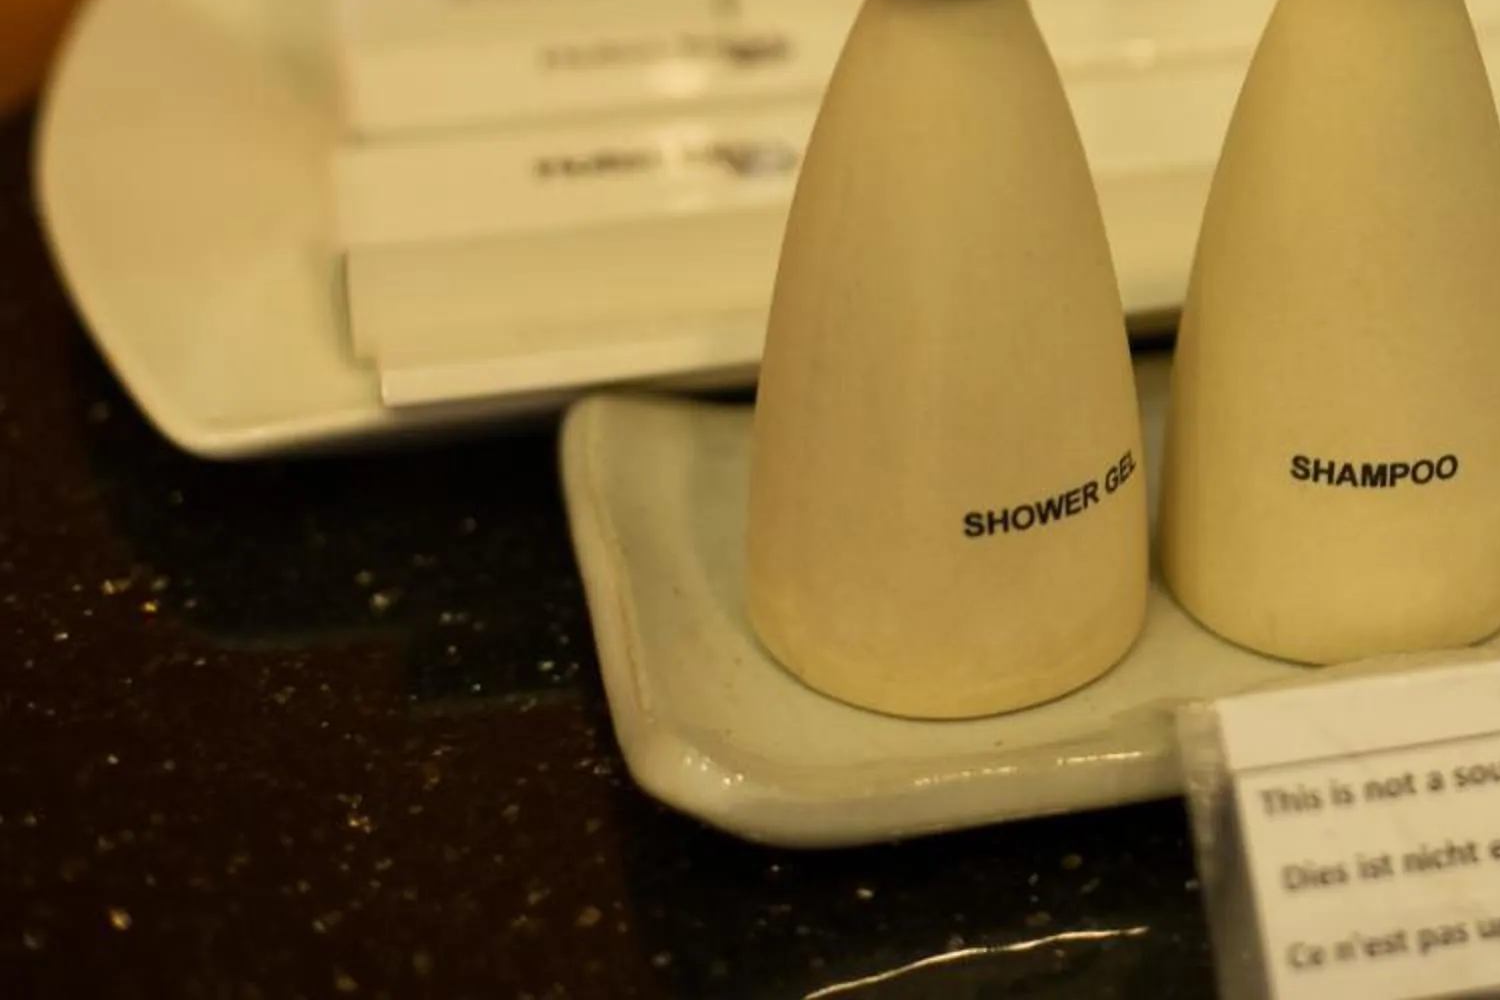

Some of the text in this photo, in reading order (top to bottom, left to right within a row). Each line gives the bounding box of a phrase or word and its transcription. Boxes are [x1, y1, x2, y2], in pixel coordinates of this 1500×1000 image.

[963, 448, 1137, 538] SHOWER GEL
[1290, 454, 1459, 488] SHAMPOO
[1259, 783, 1323, 817] This
[1330, 777, 1356, 806] is
[1363, 772, 1417, 803] not
[1426, 769, 1445, 793] a
[1282, 862, 1350, 894] Dies
[1358, 854, 1395, 882] ist
[1403, 837, 1480, 875] nicht
[1286, 938, 1326, 970] Ce
[1333, 928, 1408, 963] n'est
[1416, 920, 1470, 958] pas
